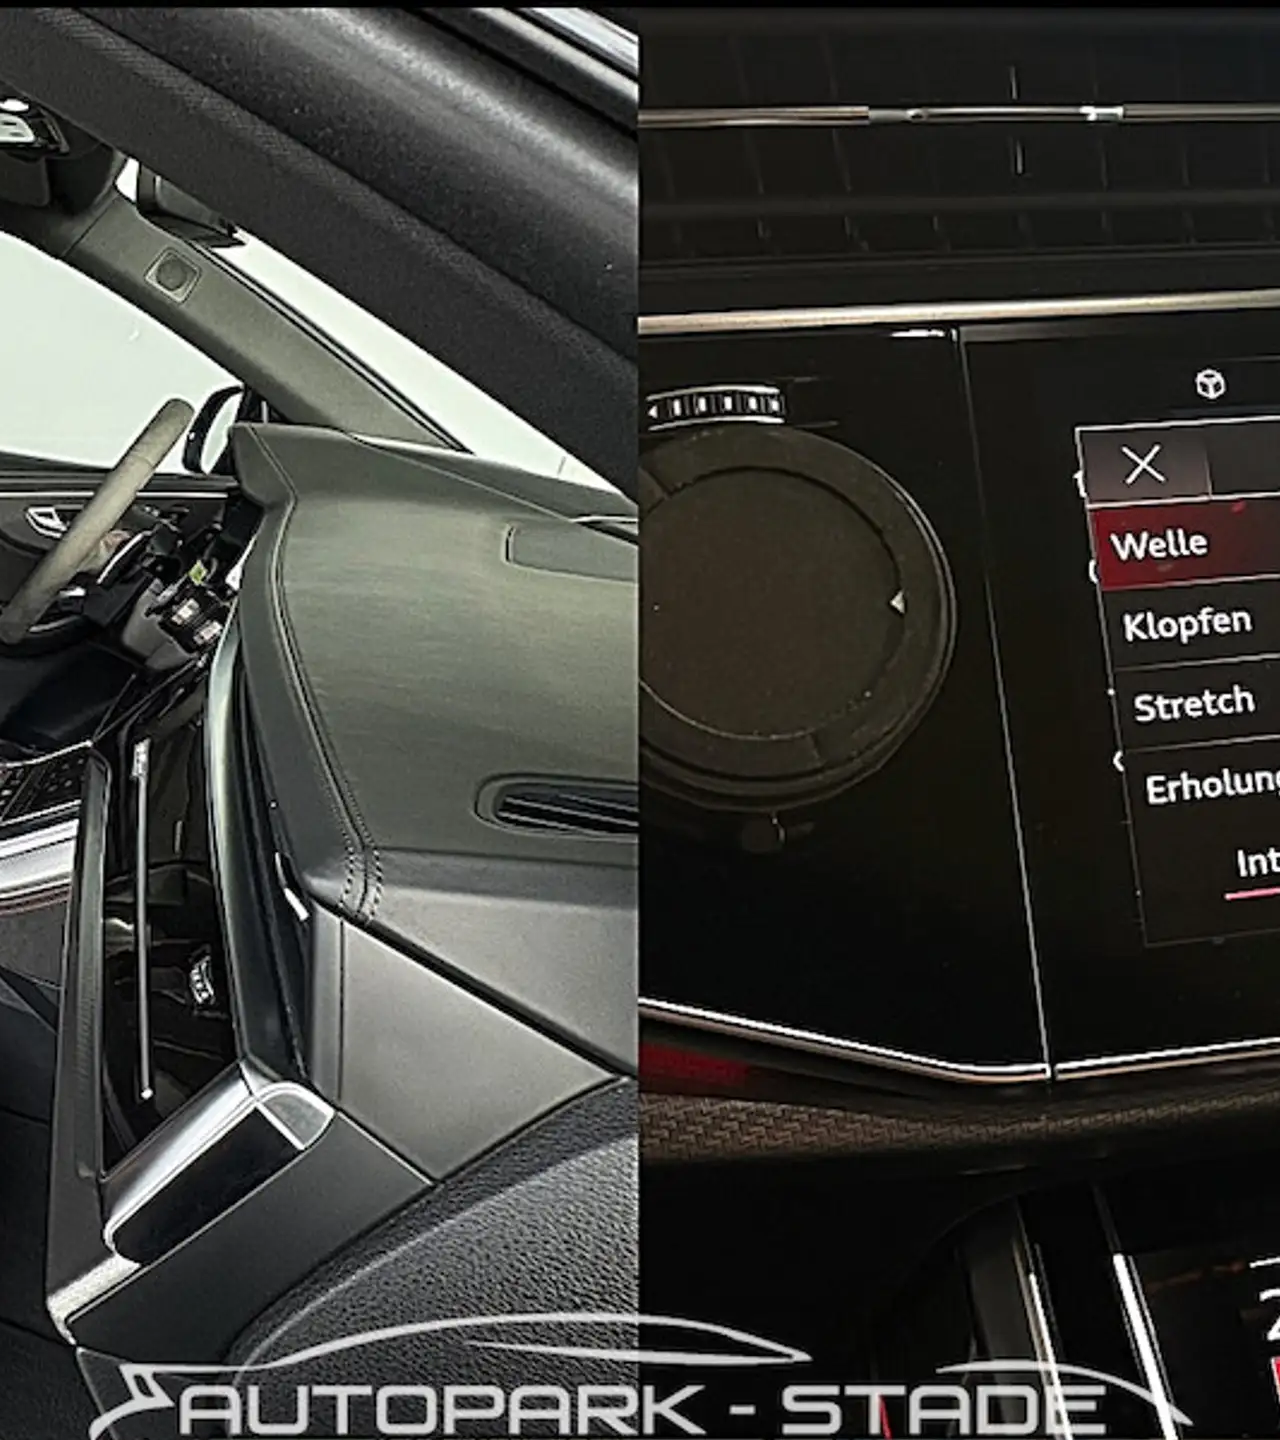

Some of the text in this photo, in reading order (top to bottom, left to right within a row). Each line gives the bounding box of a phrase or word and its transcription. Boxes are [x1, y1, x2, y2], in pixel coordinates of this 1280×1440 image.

[1110, 529, 1209, 559] Welle
[1122, 607, 1253, 643] Klopfen
[1134, 685, 1255, 723] Stretch
